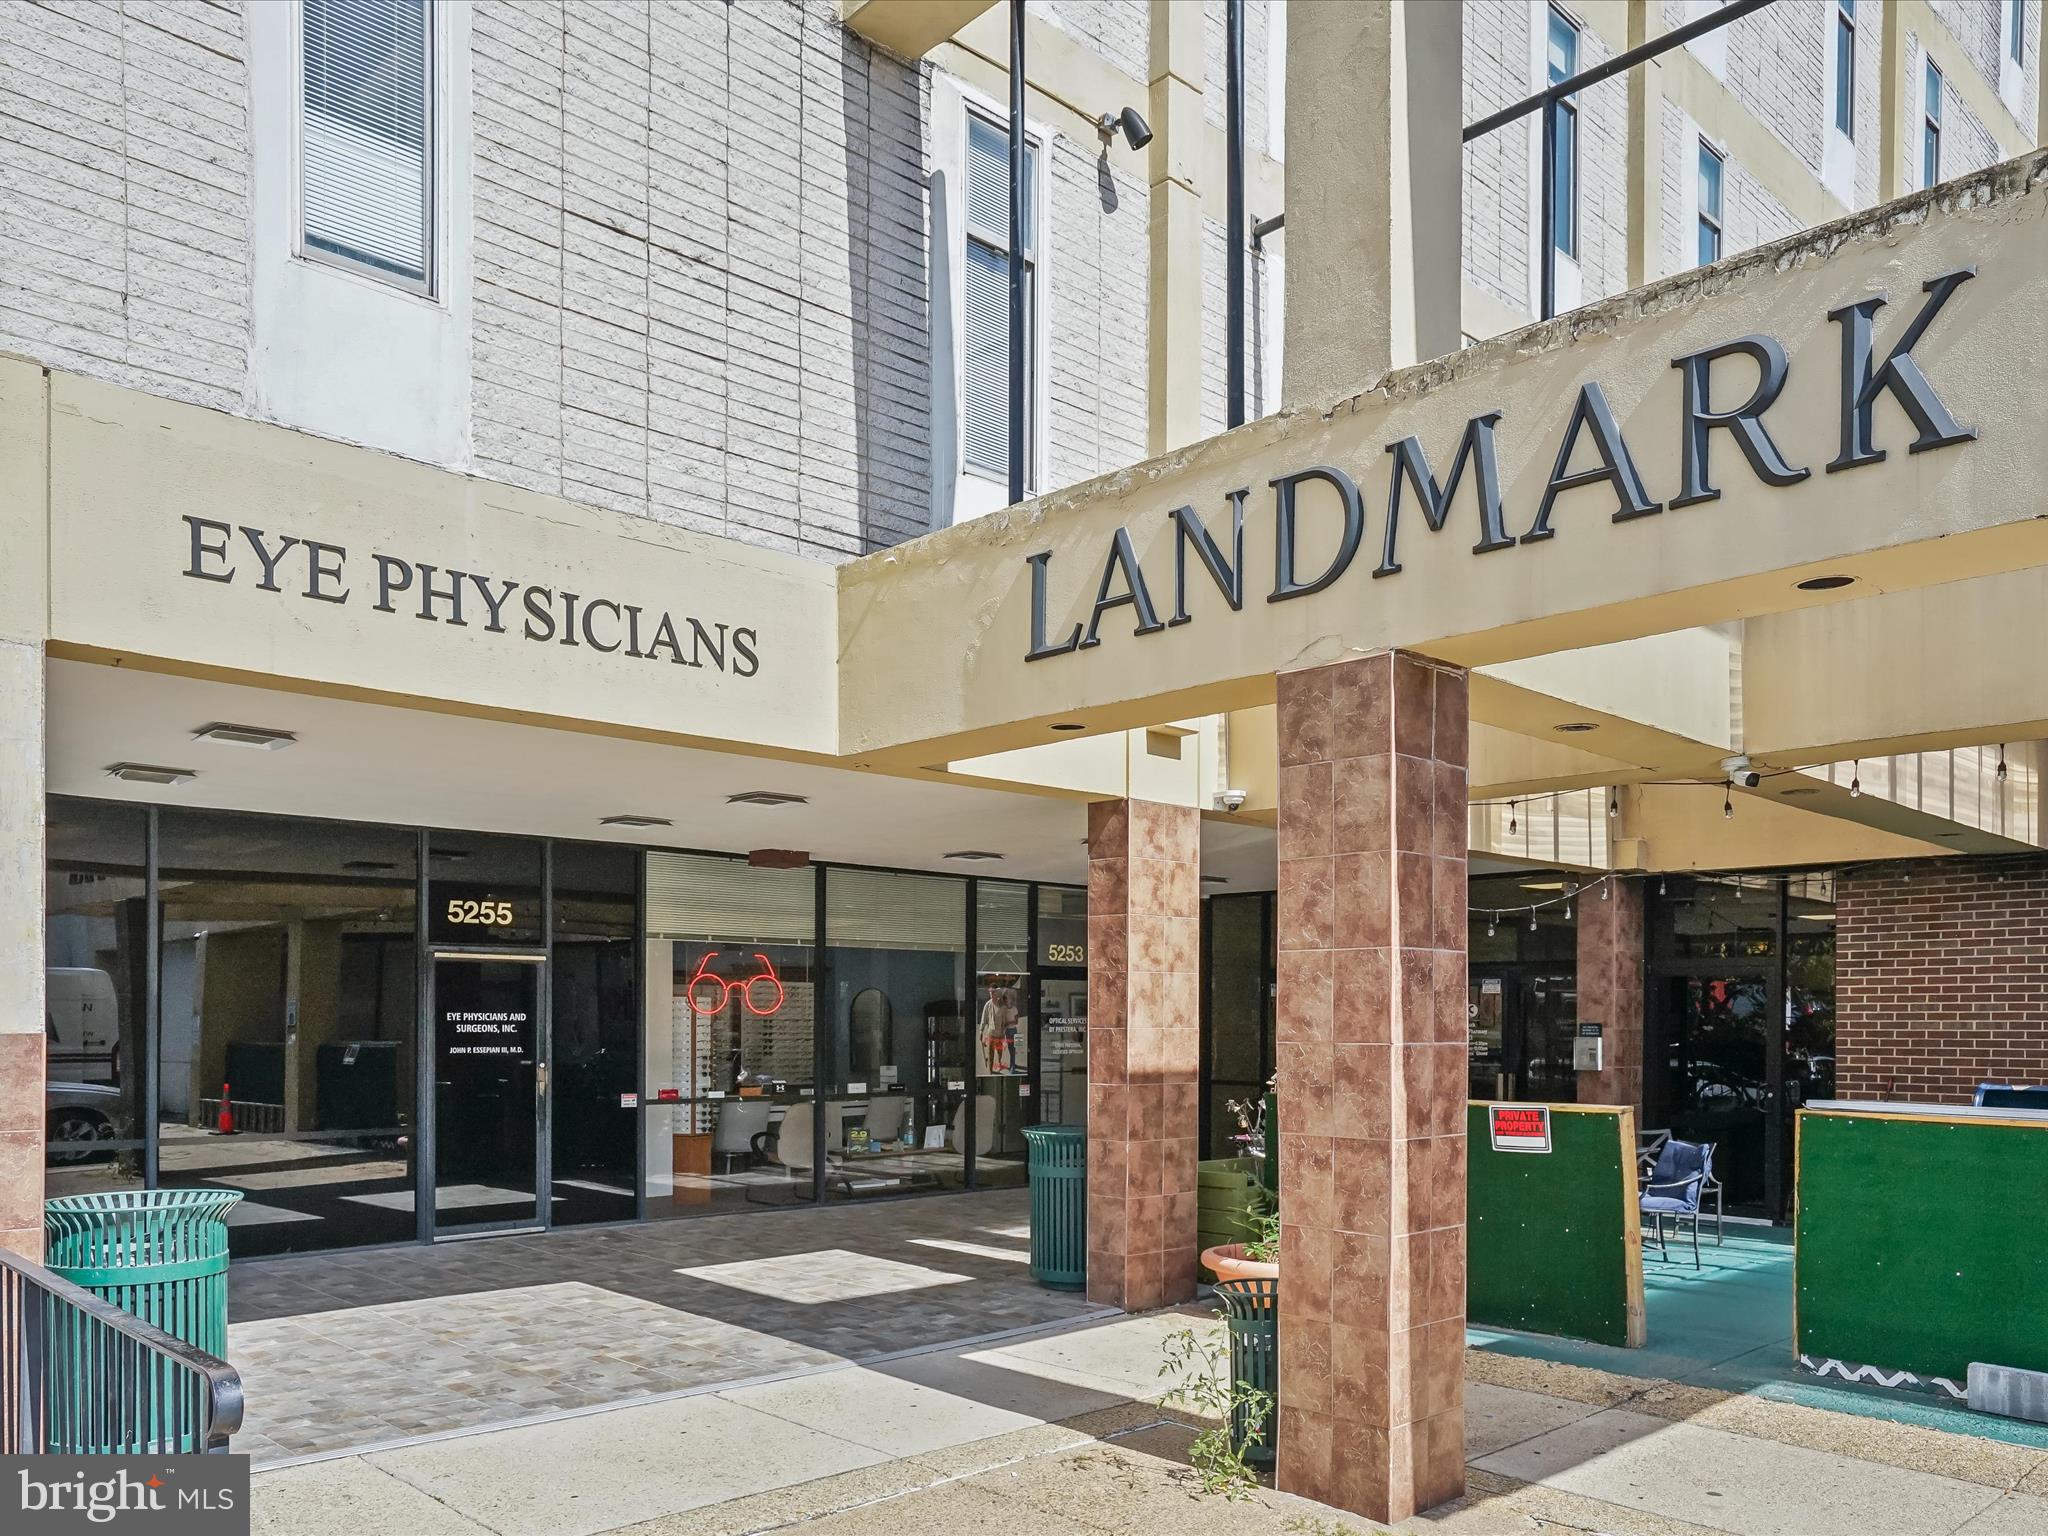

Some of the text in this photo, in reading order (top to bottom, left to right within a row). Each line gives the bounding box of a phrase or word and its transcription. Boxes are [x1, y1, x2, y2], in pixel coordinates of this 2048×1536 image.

[1023, 265, 1979, 662] LANDMARK
[182, 514, 760, 678] EYE PHYSICIANS
[447, 899, 513, 925] 5255
[1048, 944, 1084, 961] 5253
[446, 1012, 527, 1021] EYE PHYSICIANS AND
[1048, 1017, 1068, 1025] OPTICAL
[456, 1024, 518, 1034] SURGEONS, INC.
[449, 1046, 466, 1054] JOHN
[1498, 1110, 1539, 1121] PRIVATE
[1495, 1120, 1545, 1132] PROPERTY
